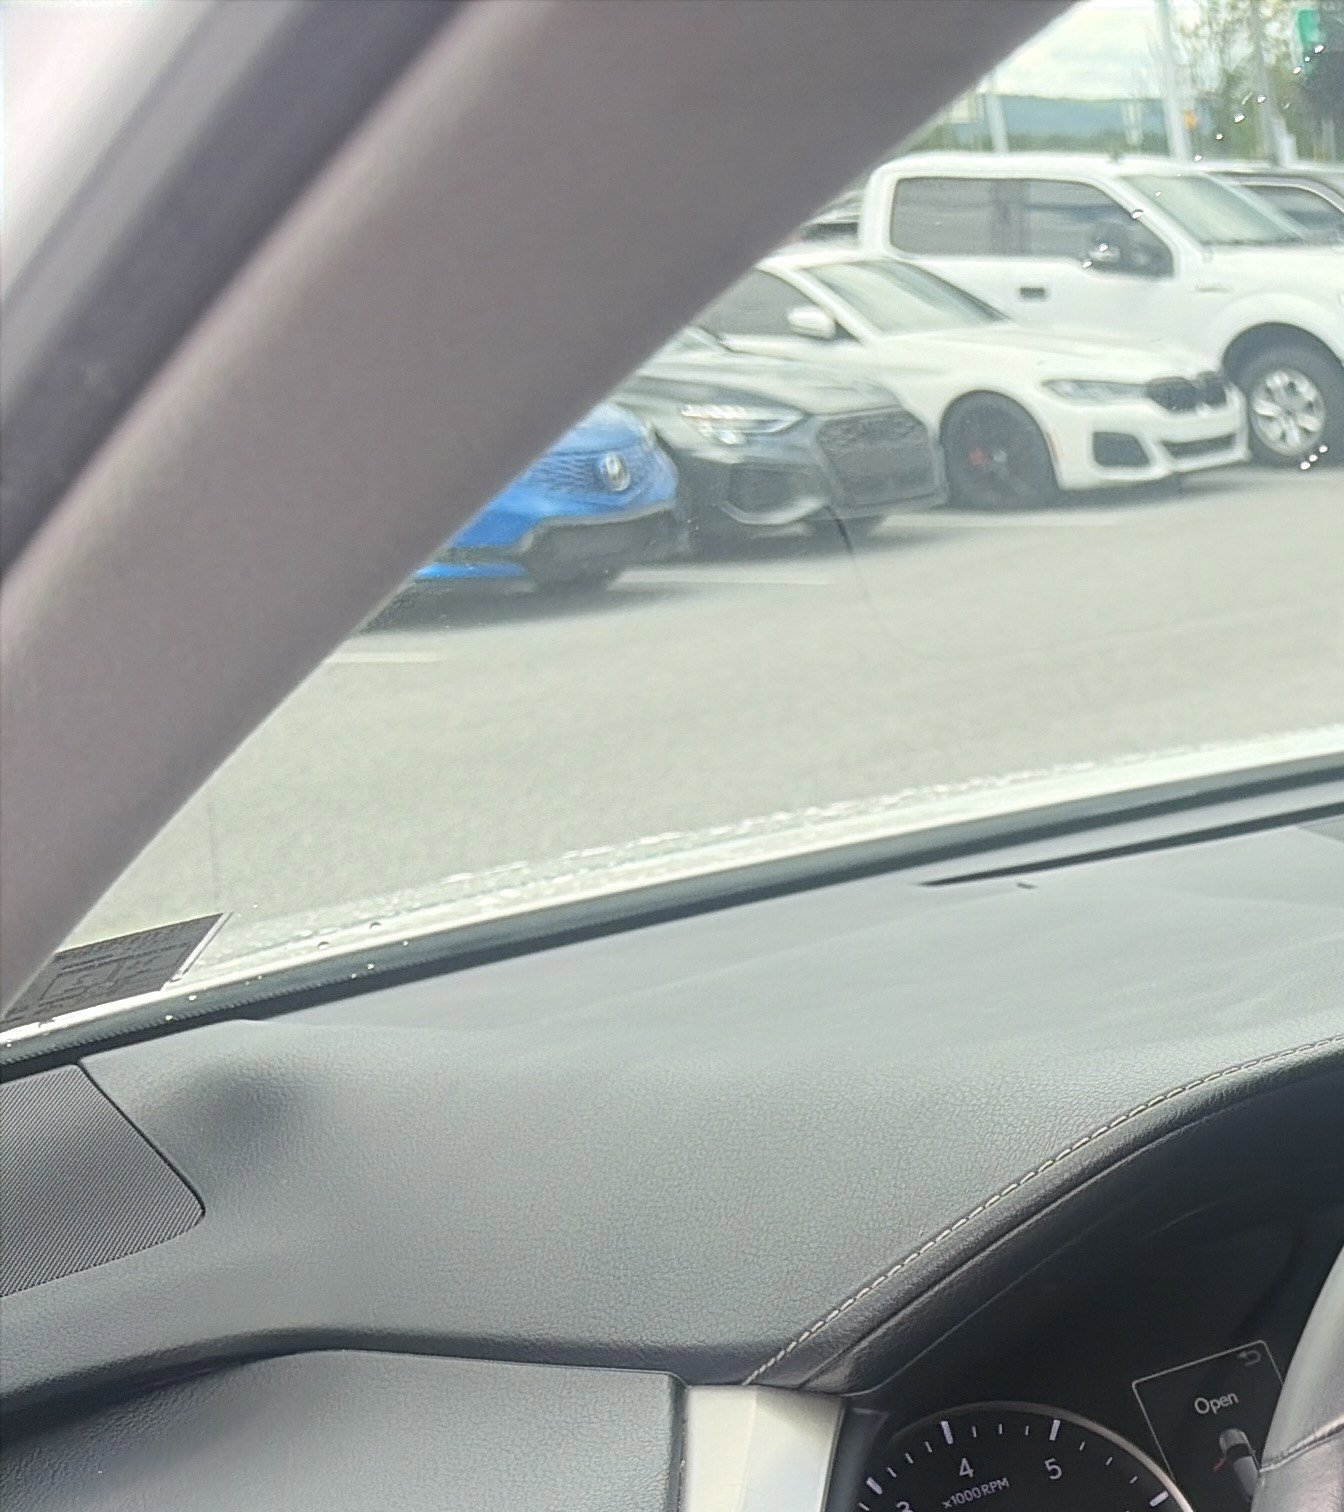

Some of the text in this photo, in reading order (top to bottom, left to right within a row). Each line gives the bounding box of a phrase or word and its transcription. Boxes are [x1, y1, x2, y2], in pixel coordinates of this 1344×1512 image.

[1194, 1392, 1240, 1415] Open
[958, 1457, 975, 1478] 4
[1044, 1458, 1062, 1481] 5
